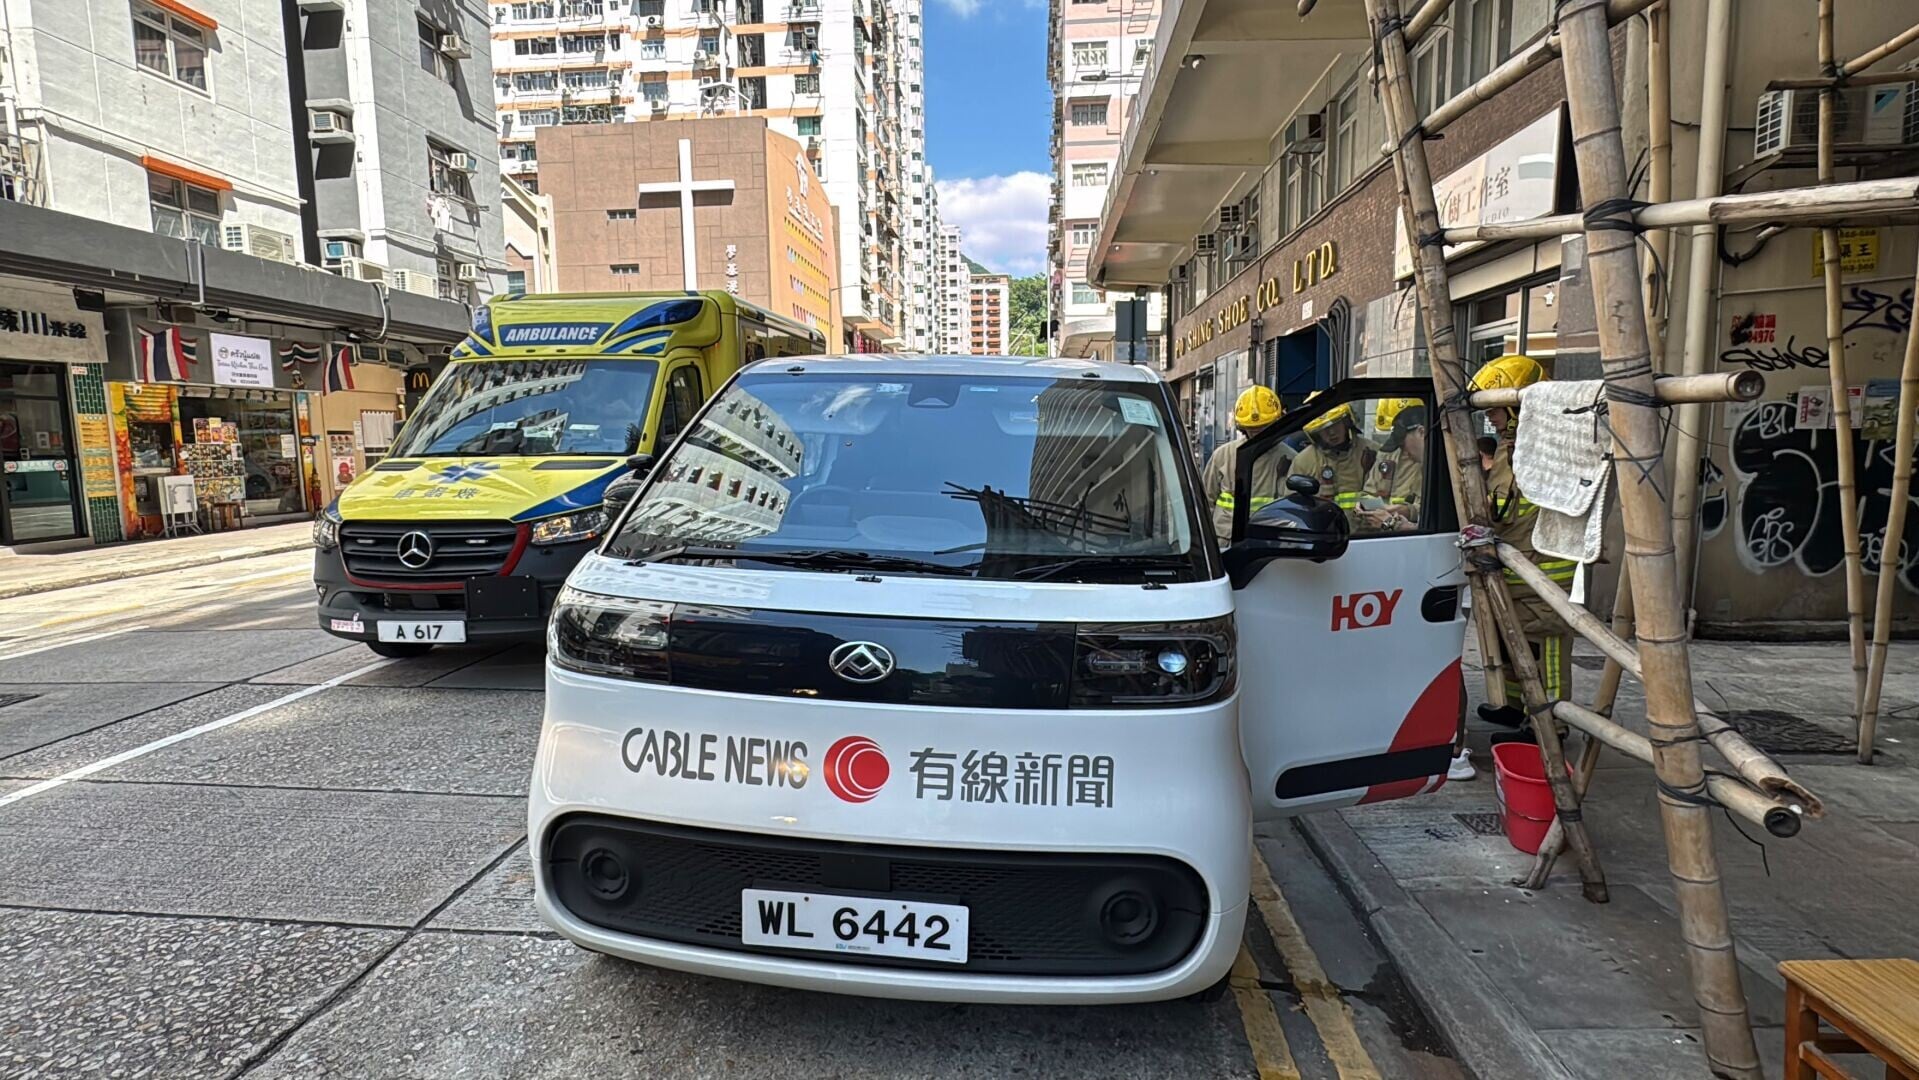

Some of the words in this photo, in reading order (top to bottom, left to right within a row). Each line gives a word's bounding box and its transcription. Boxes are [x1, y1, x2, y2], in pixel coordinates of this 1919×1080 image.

[1175, 337, 1185, 359] PO
[1187, 318, 1212, 351] SHING
[1218, 295, 1249, 334] SHOE
[1293, 240, 1336, 294] LTD.
[505, 326, 599, 342] AMBULANCE
[395, 624, 406, 640] A
[414, 624, 443, 640] 617
[1330, 588, 1403, 632] HOY
[621, 727, 718, 782] CABLE
[724, 735, 810, 790] NEWS
[909, 747, 1115, 809] 有線新聞
[757, 899, 814, 938] WL
[832, 906, 952, 951] 6442
